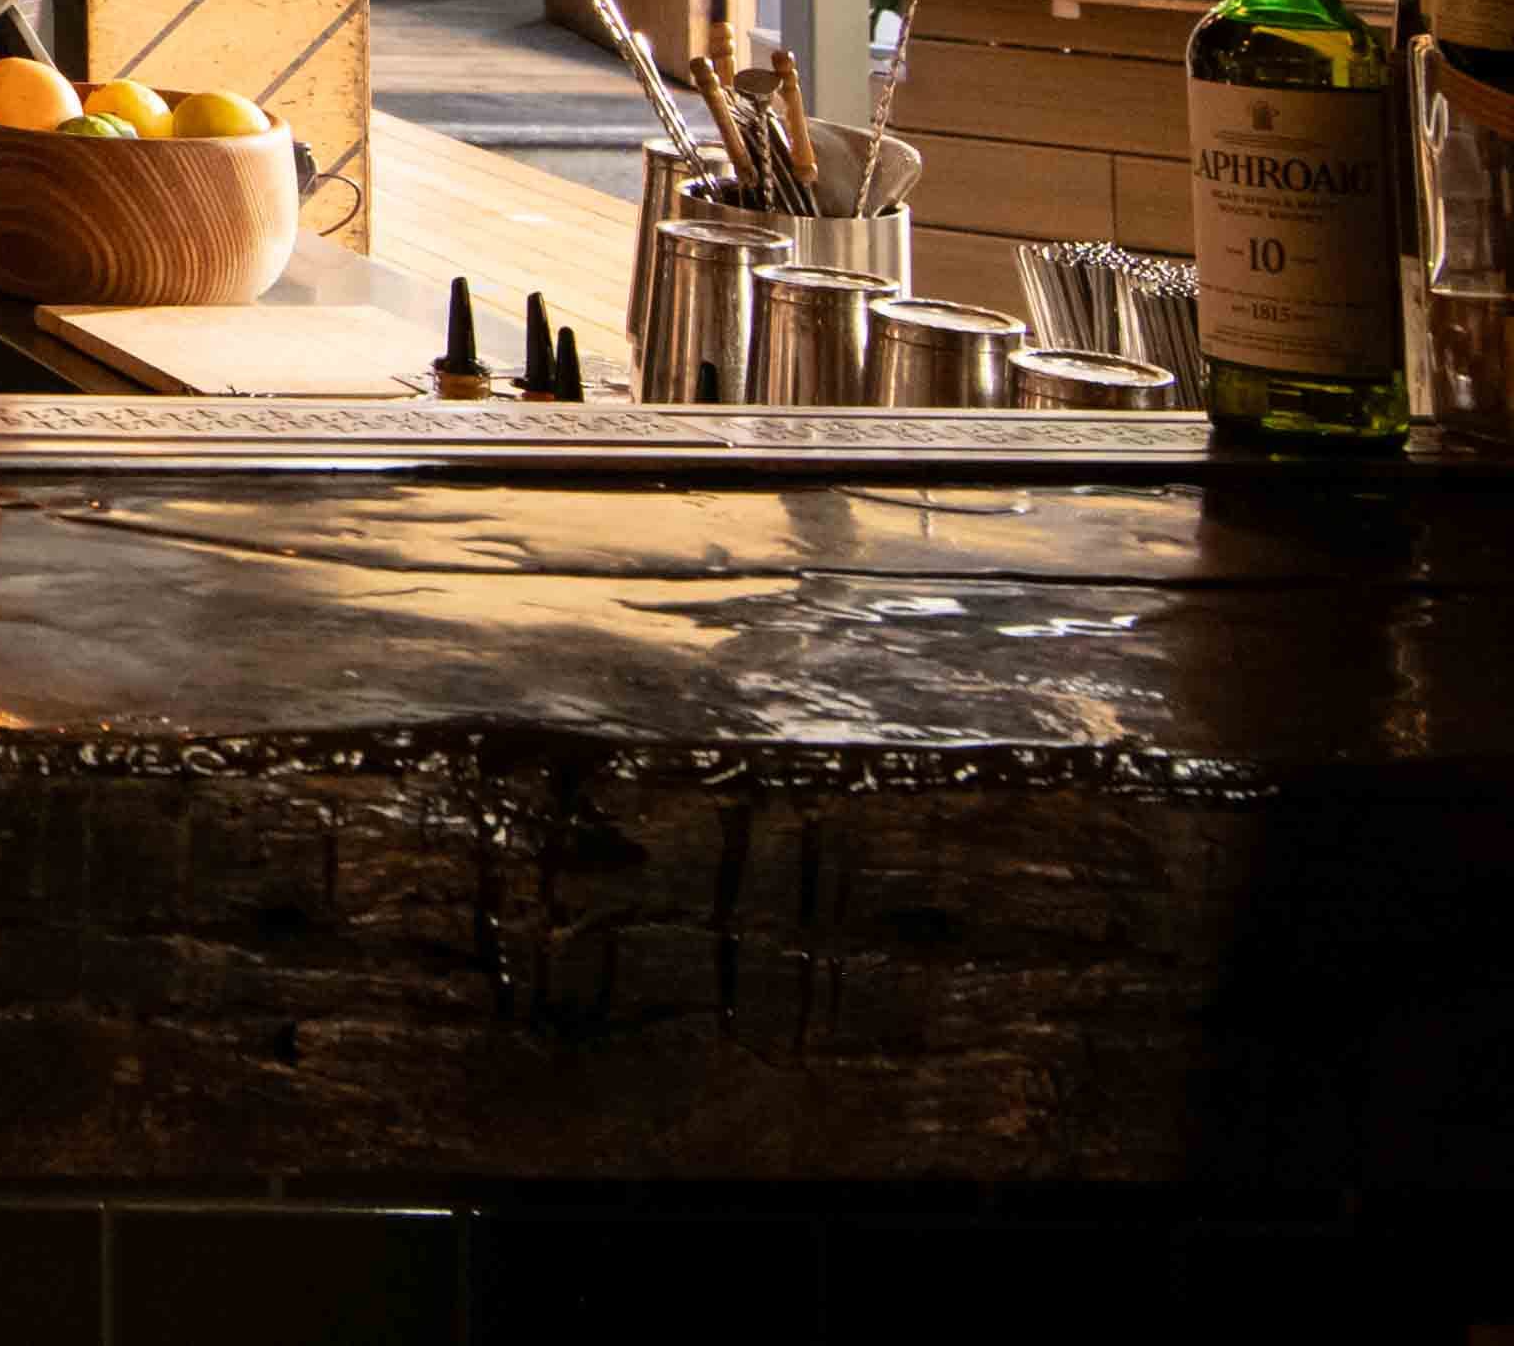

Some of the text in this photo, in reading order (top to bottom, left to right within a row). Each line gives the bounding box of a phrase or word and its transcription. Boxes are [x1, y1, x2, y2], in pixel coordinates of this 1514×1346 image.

[1193, 148, 1372, 196] APHROAIG
[1249, 236, 1285, 275] 10
[1252, 301, 1291, 323] 1815
